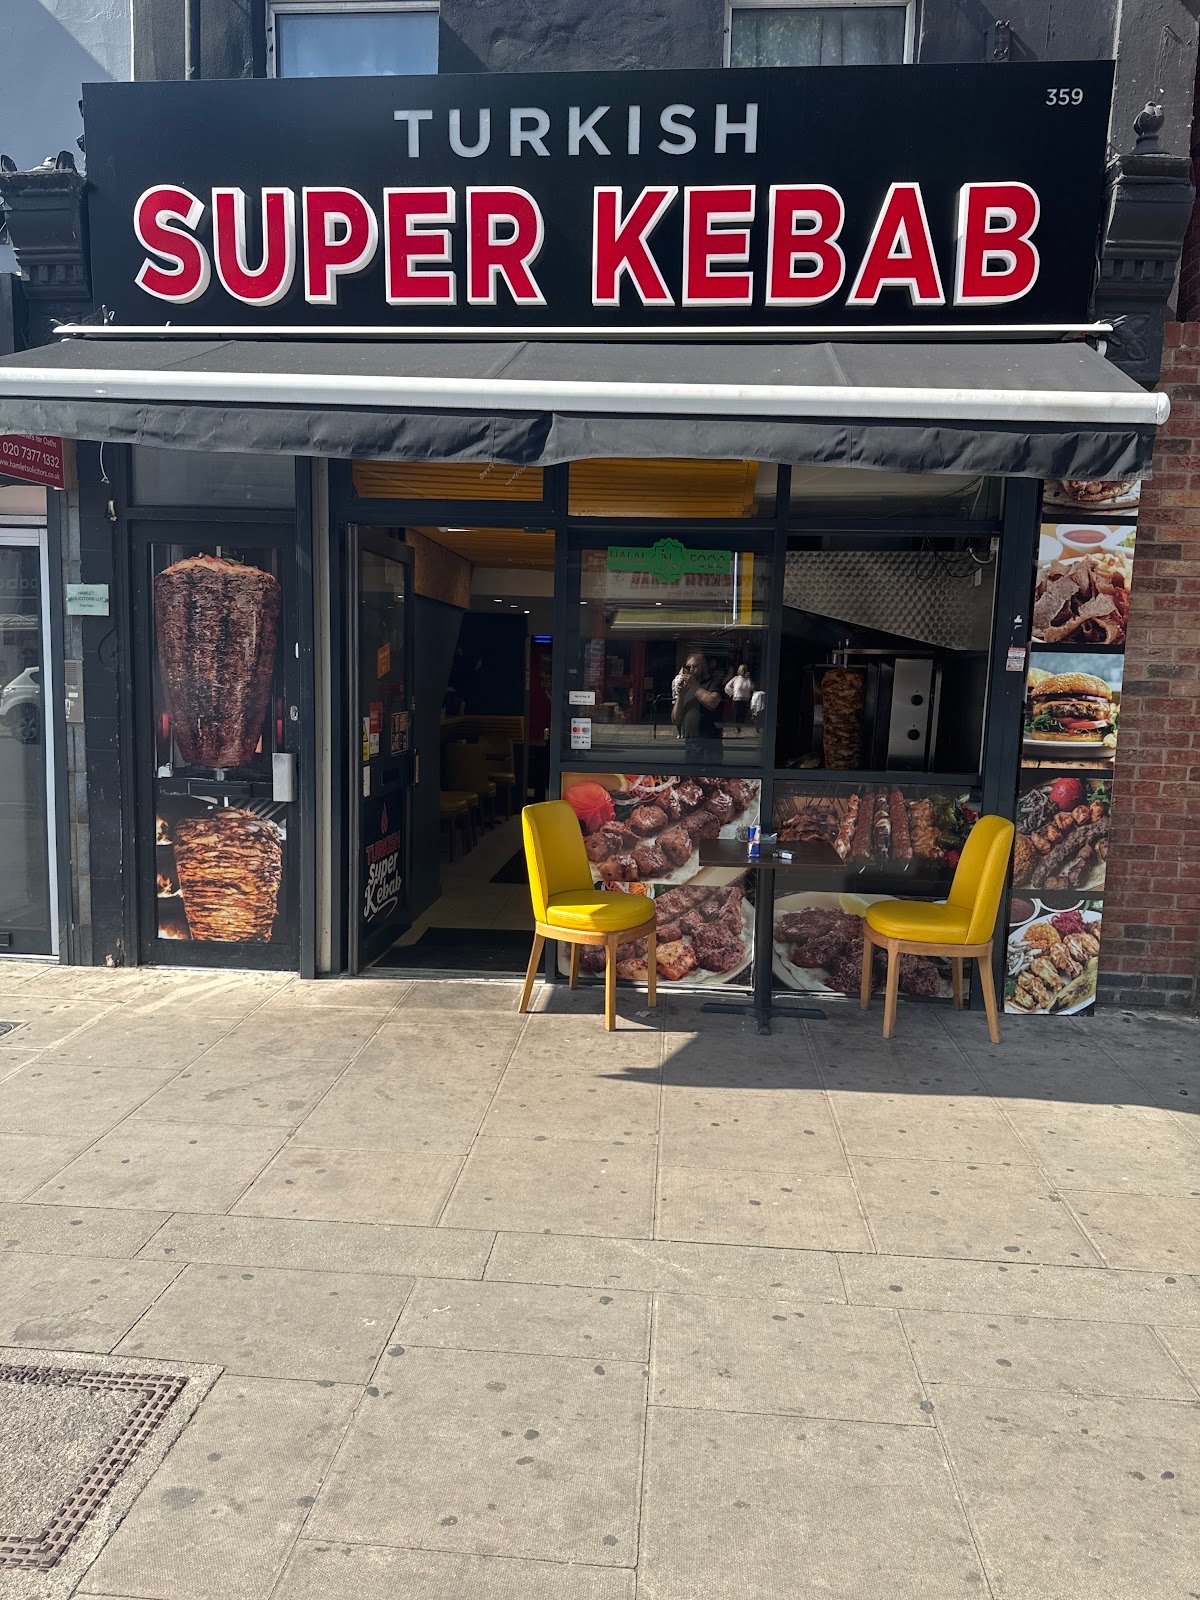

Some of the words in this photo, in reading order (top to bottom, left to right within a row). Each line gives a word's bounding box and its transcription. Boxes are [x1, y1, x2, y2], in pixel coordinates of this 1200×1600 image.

[1045, 88, 1084, 107] 359
[393, 102, 760, 159] TURKISH
[133, 183, 547, 307] SUPER
[591, 181, 1041, 308] KEBAB
[2, 441, 20, 457] 020
[21, 446, 41, 462] 7377
[42, 453, 60, 468] 1332
[365, 831, 401, 865] TURKISH
